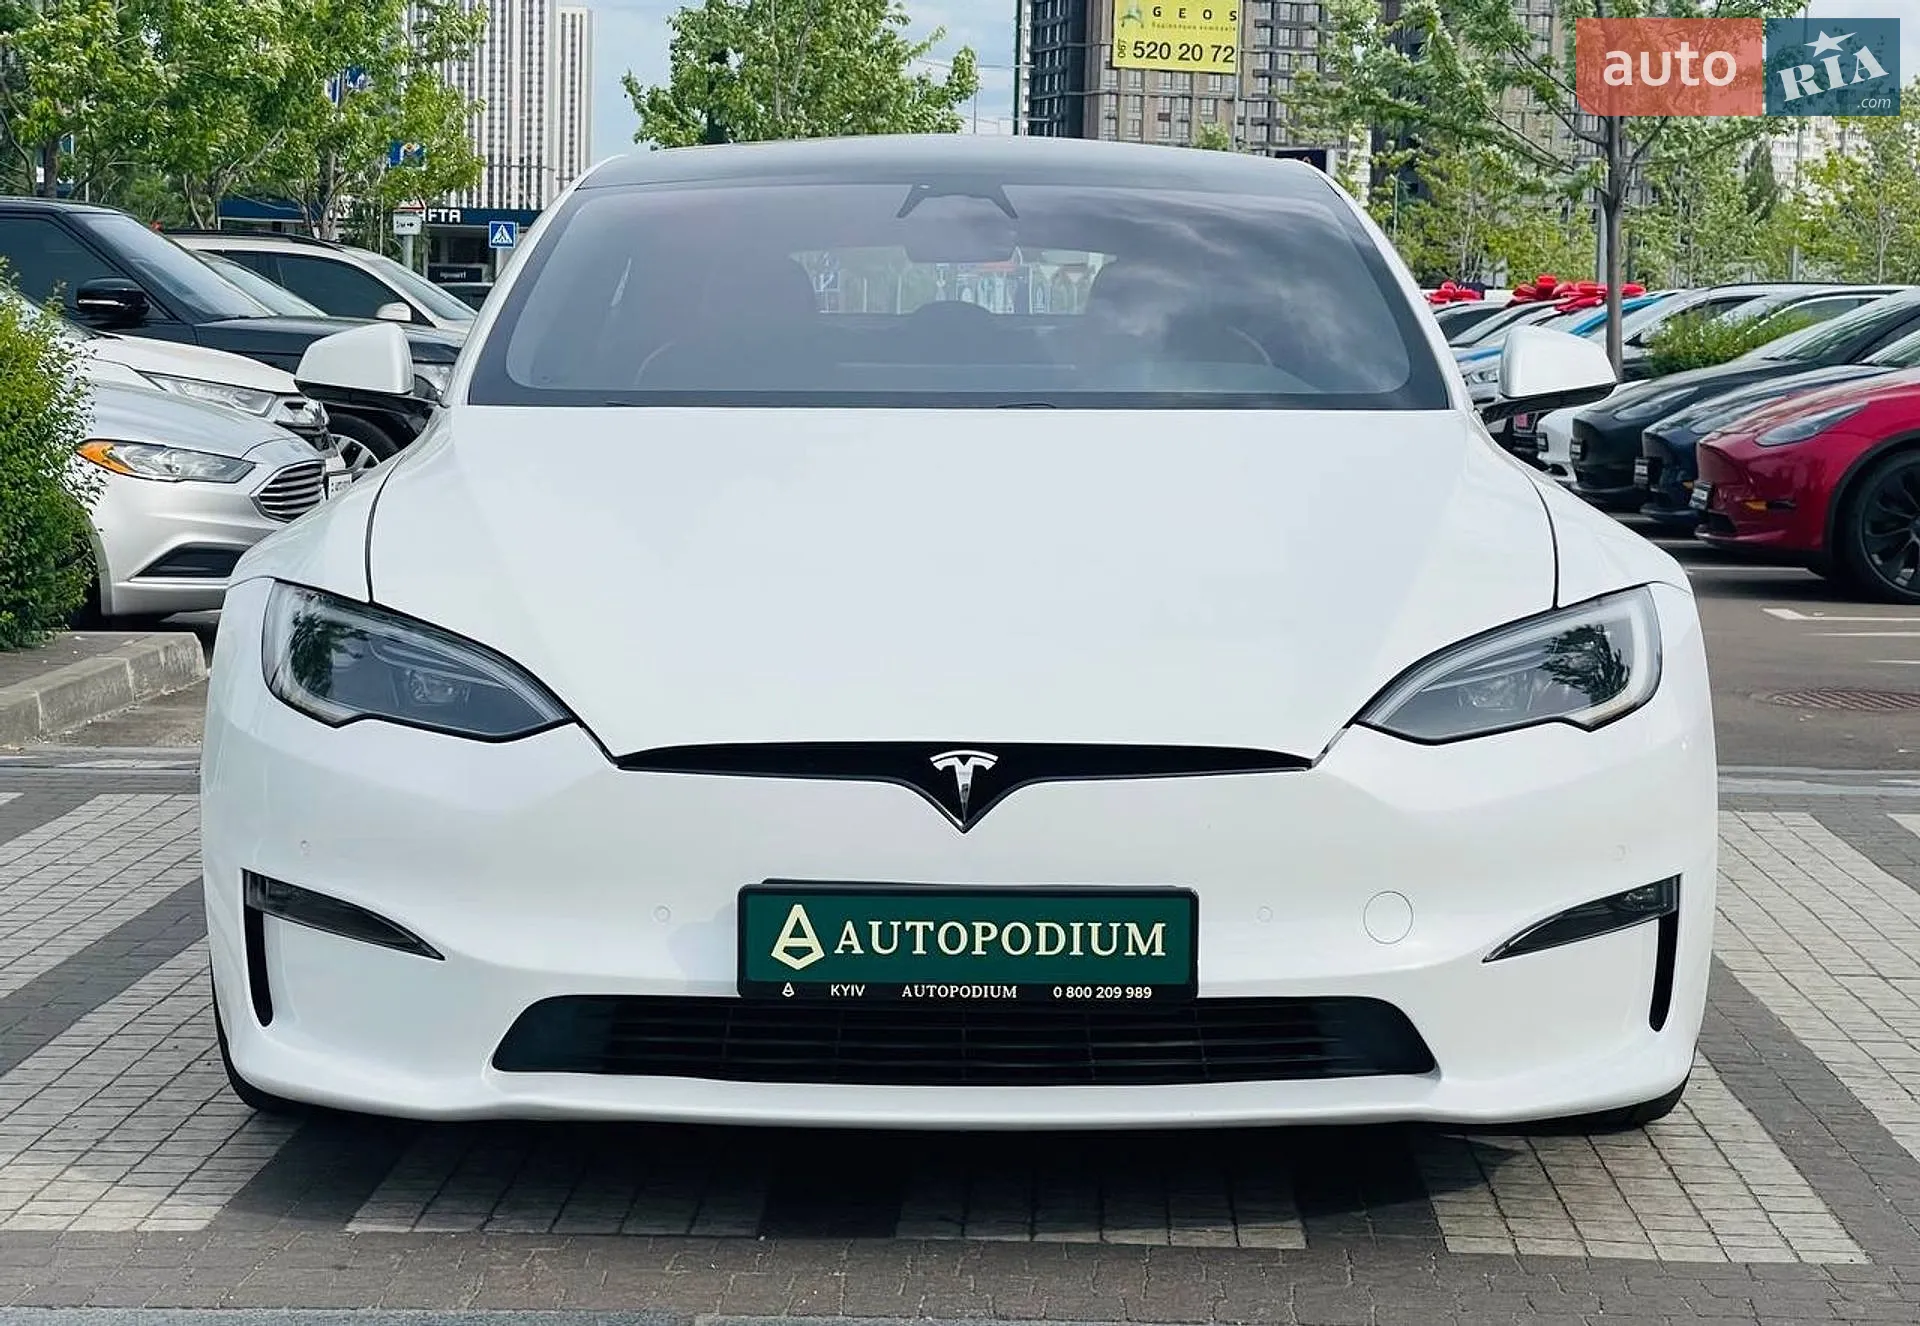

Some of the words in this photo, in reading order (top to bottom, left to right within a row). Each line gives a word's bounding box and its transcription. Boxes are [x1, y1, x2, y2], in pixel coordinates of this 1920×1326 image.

[1152, 6, 1237, 21] GEOS
[1132, 41, 1172, 60] 520
[1178, 43, 1203, 62] 20
[1210, 44, 1236, 63] 72
[833, 920, 1167, 957] AUTOPODIUM
[830, 983, 866, 997] KYIV
[901, 984, 1018, 999] AUTOPODIUM
[1065, 985, 1093, 999] 800
[1096, 986, 1122, 999] 209
[1125, 986, 1153, 999] 989
